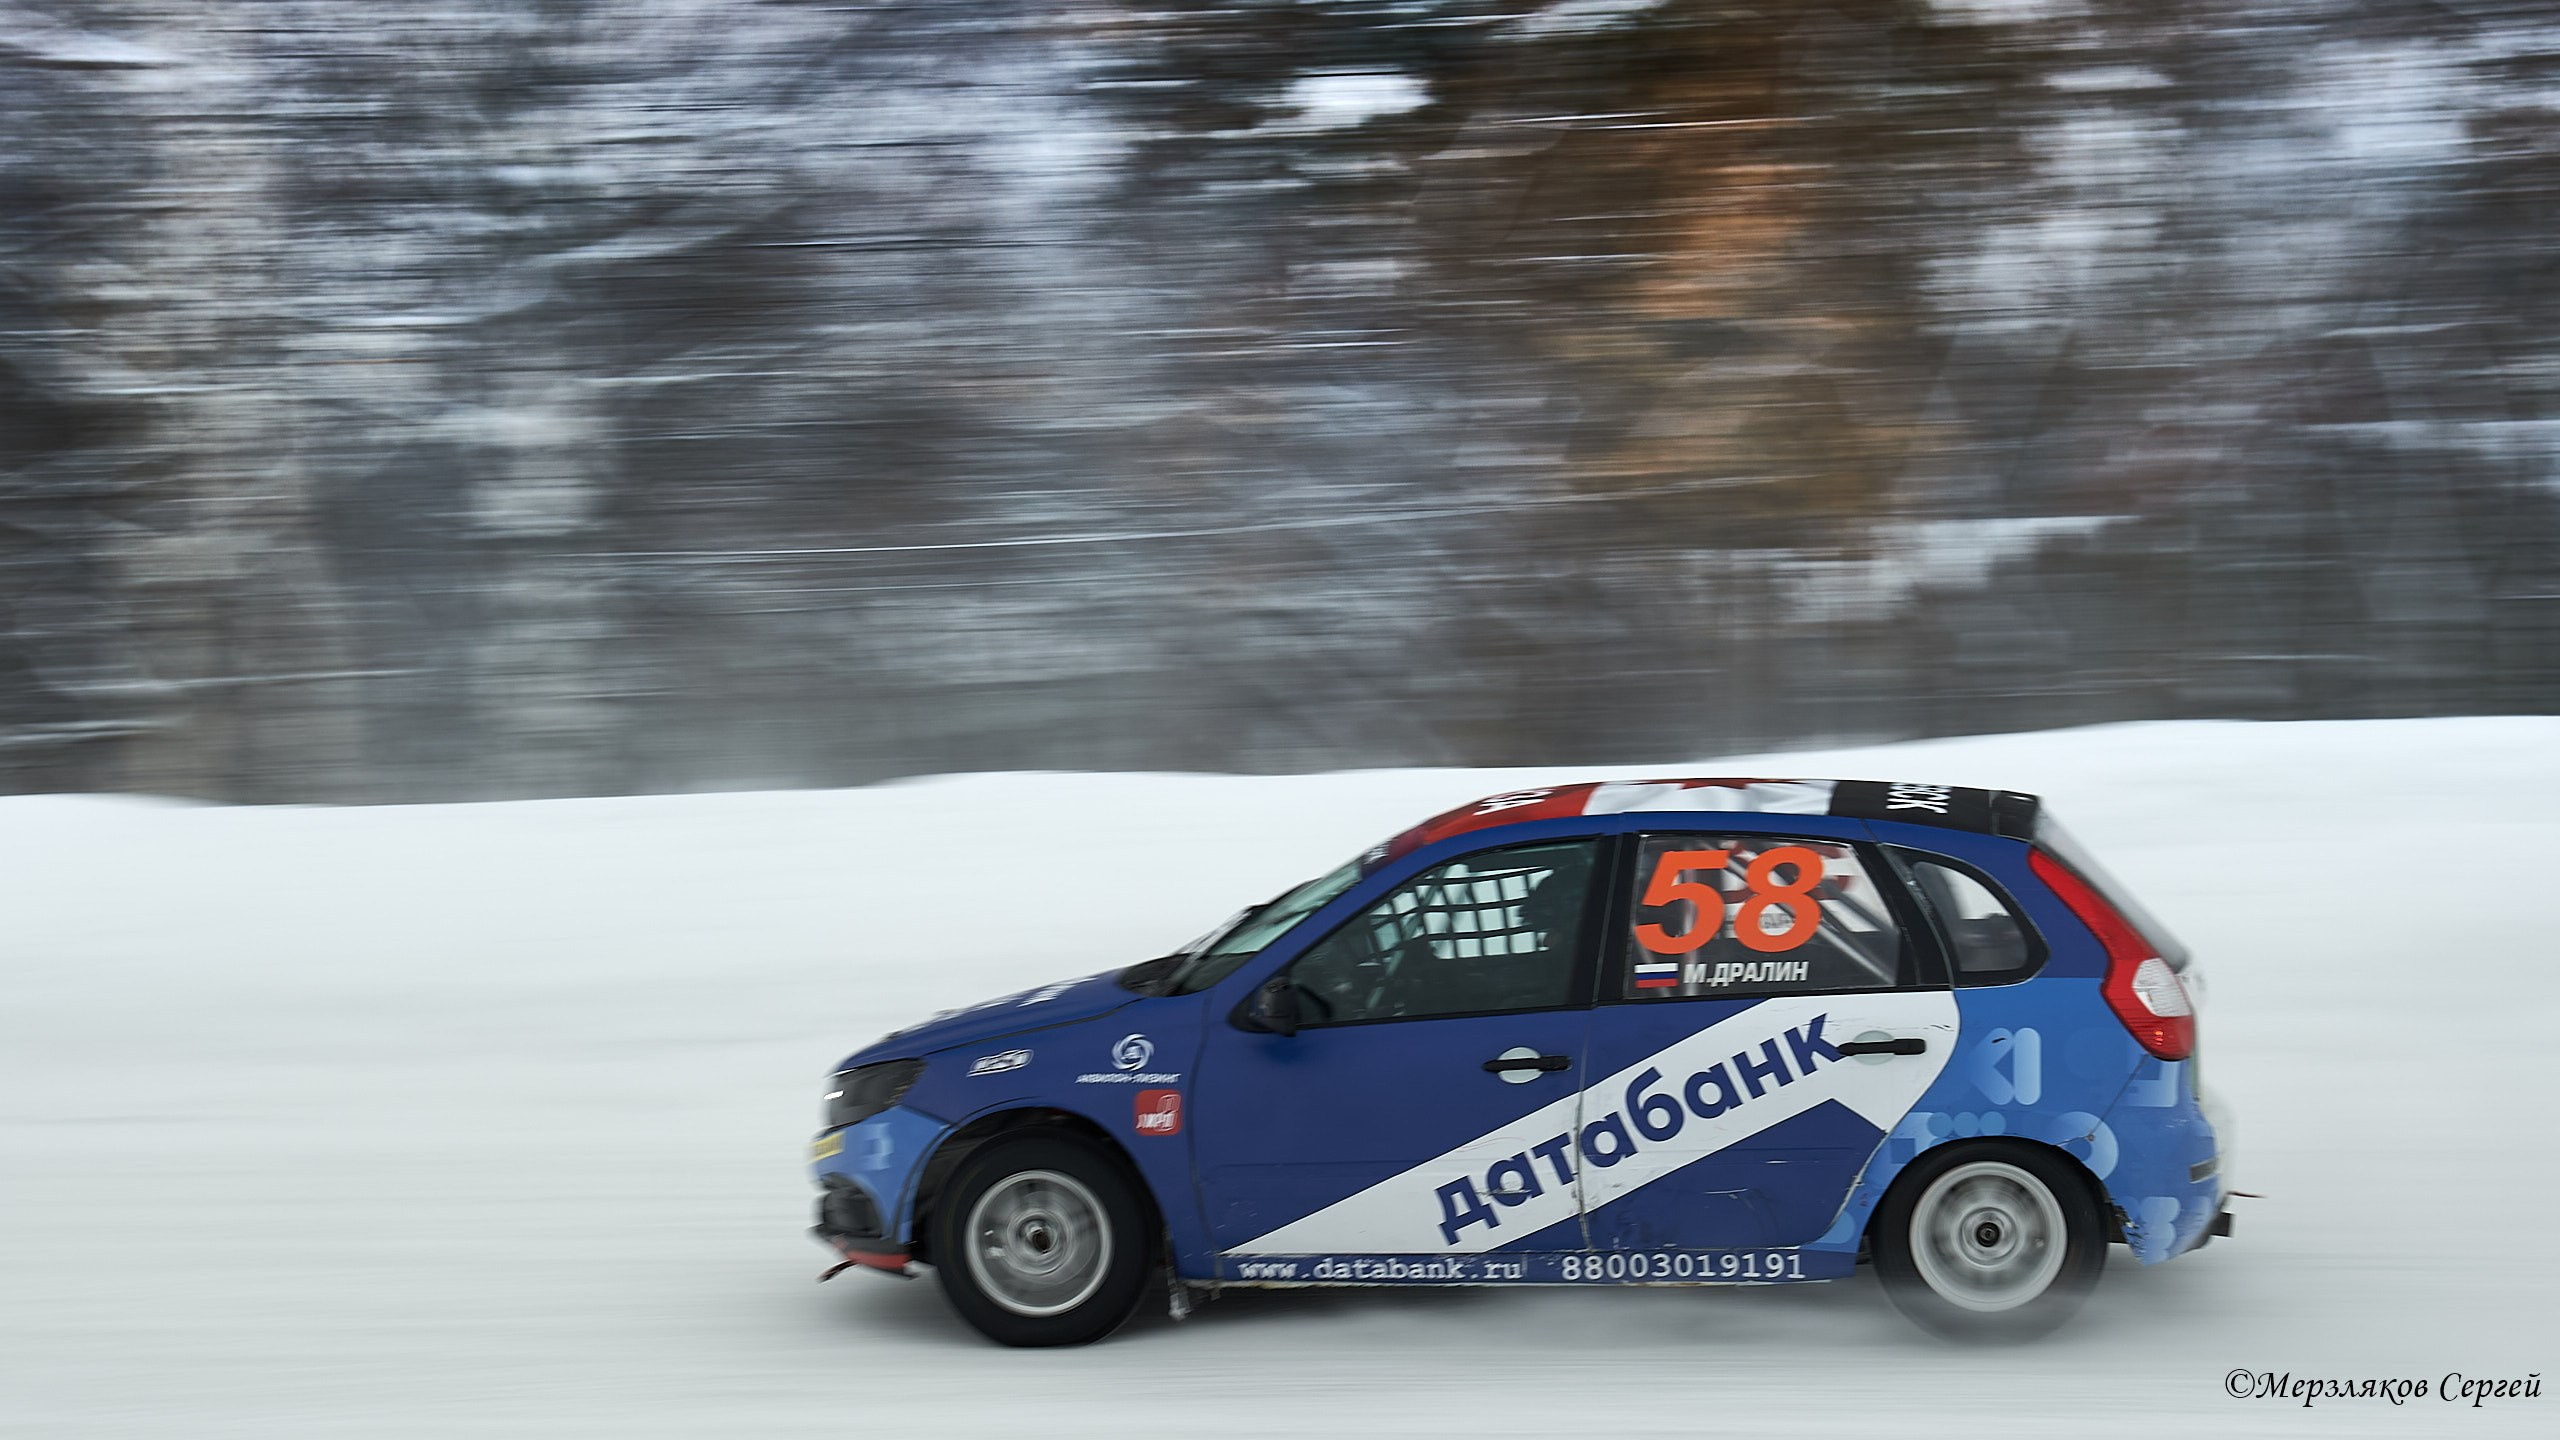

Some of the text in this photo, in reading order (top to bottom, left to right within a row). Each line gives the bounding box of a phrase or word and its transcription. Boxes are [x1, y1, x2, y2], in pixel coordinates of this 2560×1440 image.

[1634, 846, 1823, 955] 58
[1683, 961, 1809, 987] М.ДРАЛИН
[1434, 1013, 1846, 1247] датабанк
[1237, 1253, 1806, 1281] www.databank.ru 88003019191
